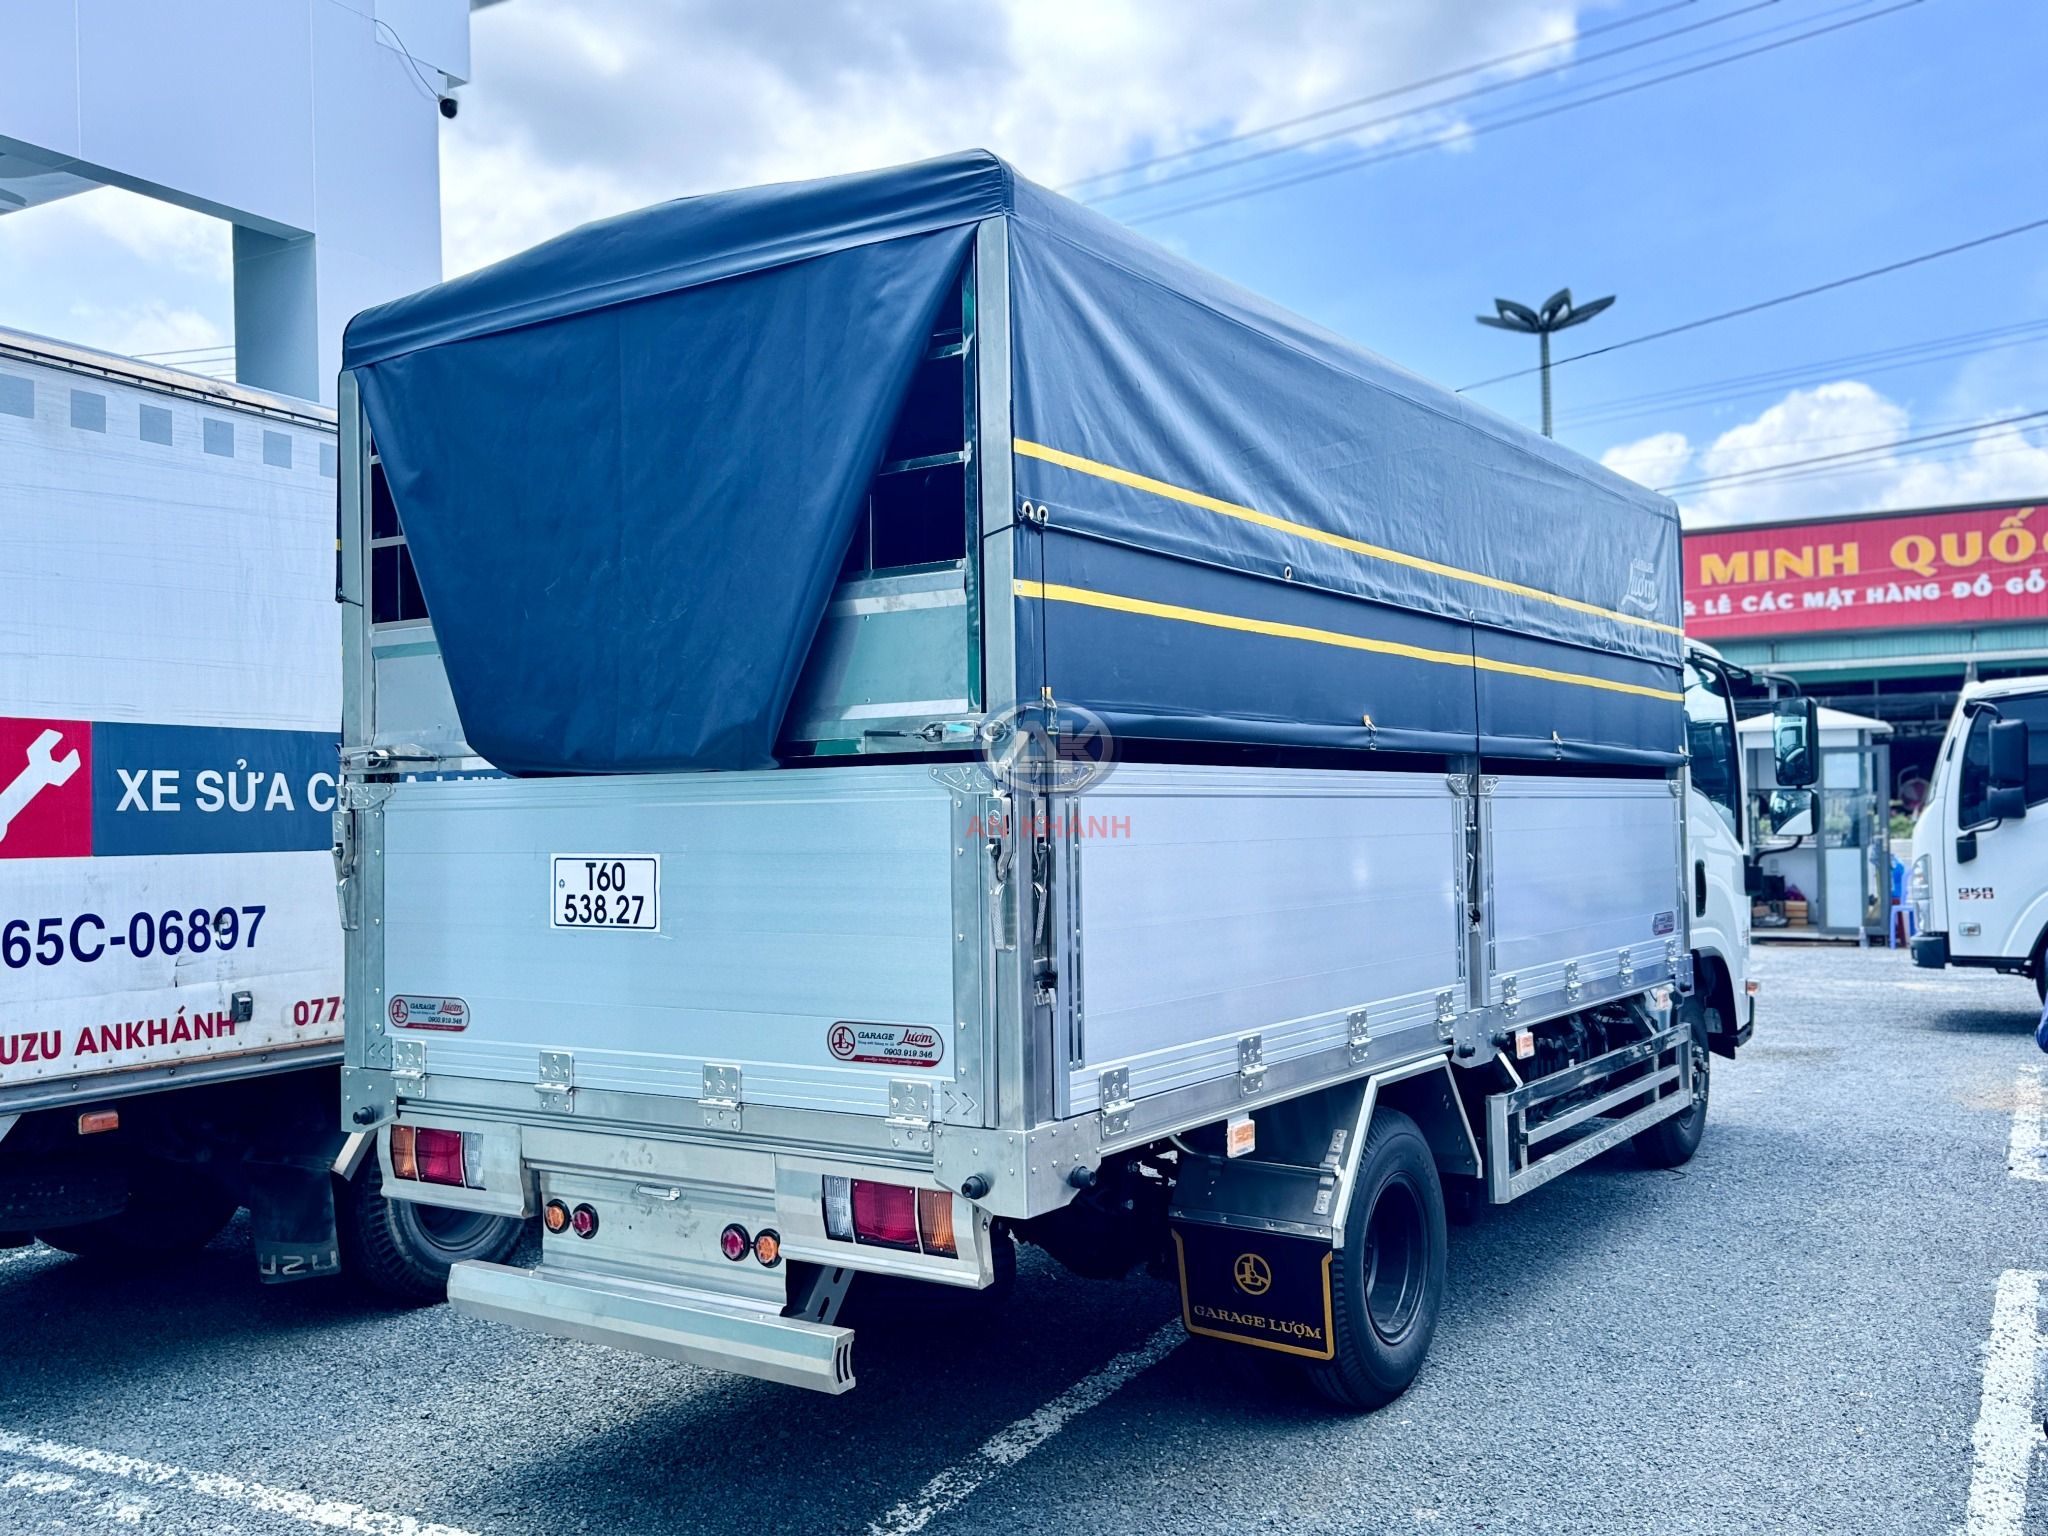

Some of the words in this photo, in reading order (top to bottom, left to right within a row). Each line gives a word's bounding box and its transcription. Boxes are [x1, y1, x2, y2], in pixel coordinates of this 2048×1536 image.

[1701, 542, 1859, 586] MINH
[1890, 507, 2048, 577] QUỐ
[1741, 590, 1795, 612] CÁC
[1866, 582, 1940, 605] HÀNG
[116, 769, 181, 811] XE
[195, 758, 295, 812] SỬA
[585, 862, 625, 892] T60
[564, 894, 644, 924] 538.27
[1, 905, 266, 969] 65C-06897
[74, 1004, 236, 1056] ANKHÁNH
[858, 1031, 895, 1041] GARAGE
[1194, 1305, 1266, 1329] GARAGE
